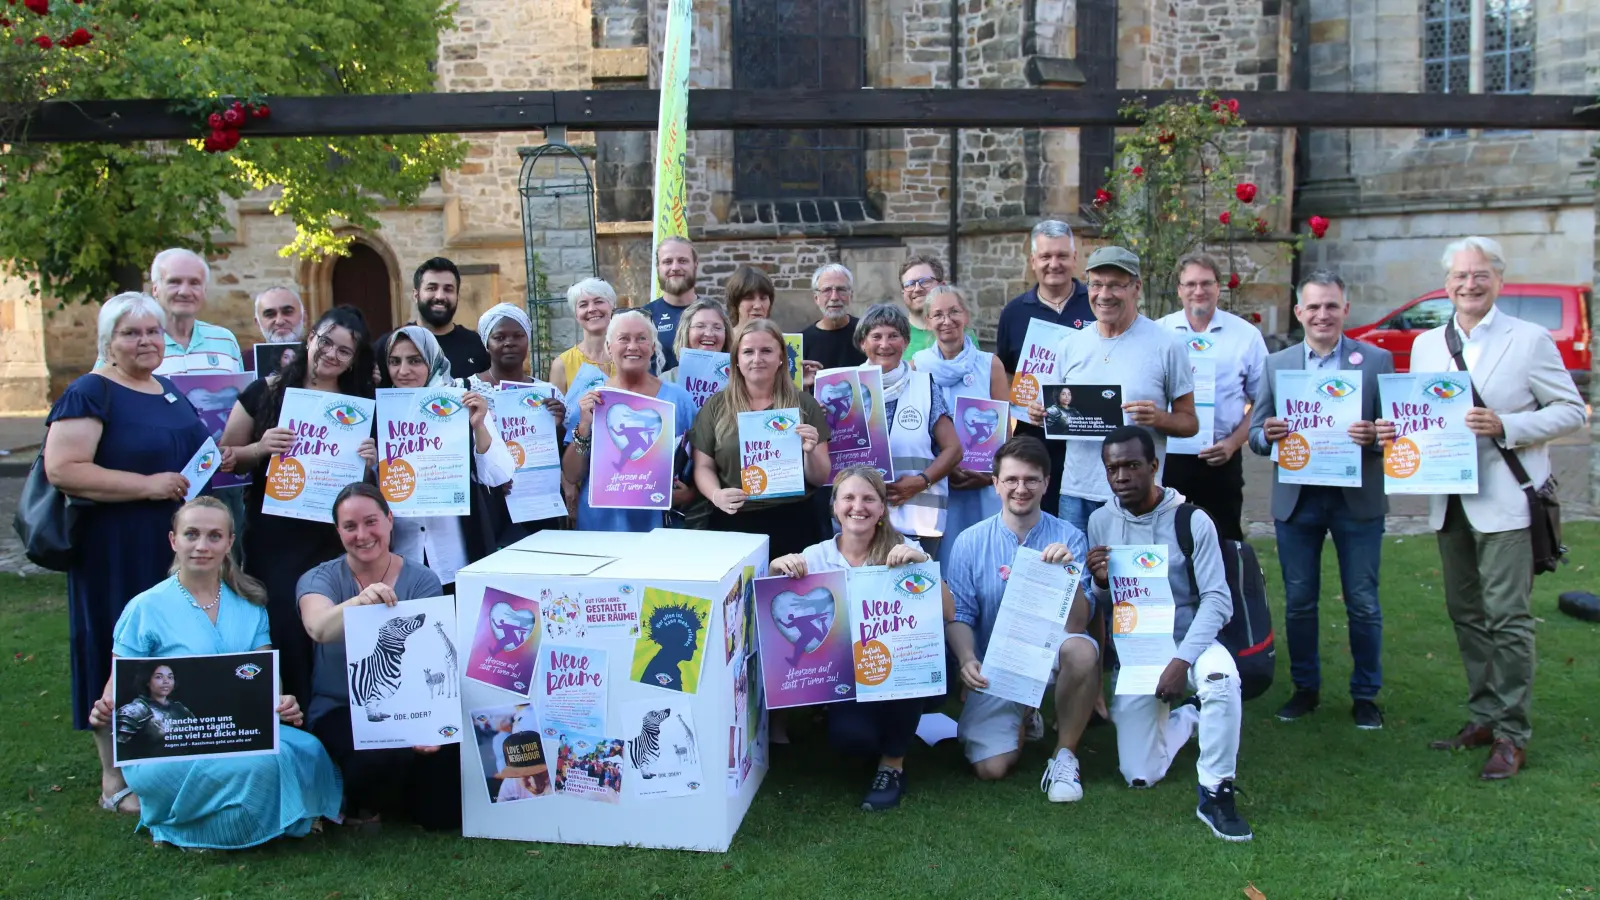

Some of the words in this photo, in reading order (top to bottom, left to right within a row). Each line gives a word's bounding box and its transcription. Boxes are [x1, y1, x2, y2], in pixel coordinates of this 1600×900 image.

[1029, 344, 1057, 362] Neu
[685, 376, 719, 393] Neue
[1286, 399, 1323, 416] Neue
[1392, 402, 1431, 419] Neue
[289, 419, 330, 439] Neue
[502, 416, 527, 429] Neue
[388, 420, 428, 440] Neue
[386, 437, 443, 465] Räume
[745, 440, 772, 453] Neue
[744, 450, 781, 470] Räume
[836, 452, 860, 461] Herzen
[611, 472, 638, 483] Herzen
[638, 470, 652, 481] auf
[605, 483, 620, 492] statt
[644, 481, 656, 490] zu!
[1113, 576, 1139, 588] Neue
[1059, 578, 1075, 619] PROGRAMM
[1114, 587, 1151, 606] Räume
[586, 603, 627, 613] GESTALTET
[862, 599, 903, 620] Neue
[587, 614, 606, 623] NEUE
[607, 612, 638, 621] RÄUME!
[860, 615, 917, 647] Räume
[485, 656, 507, 667] Herzen
[551, 650, 590, 670] Neue
[785, 668, 817, 680] Herzen
[818, 661, 832, 674] auf
[546, 669, 602, 695] Räume
[781, 679, 798, 690] statt
[800, 677, 825, 688] Türen
[826, 672, 839, 682] zu!
[164, 717, 198, 725] Manche
[410, 711, 431, 719] ODER?
[164, 724, 204, 733] brauchen
[206, 722, 235, 732] täglich
[164, 733, 183, 741] eine
[184, 731, 200, 739] viel
[214, 730, 237, 738] dicke
[238, 728, 261, 736] Haut.
[506, 745, 520, 755] LOVE
[521, 741, 539, 752] YOUR
[508, 751, 541, 763] NEIGHBOUR
[567, 774, 598, 783] willkommen
[566, 782, 607, 793] Interkulturellen
